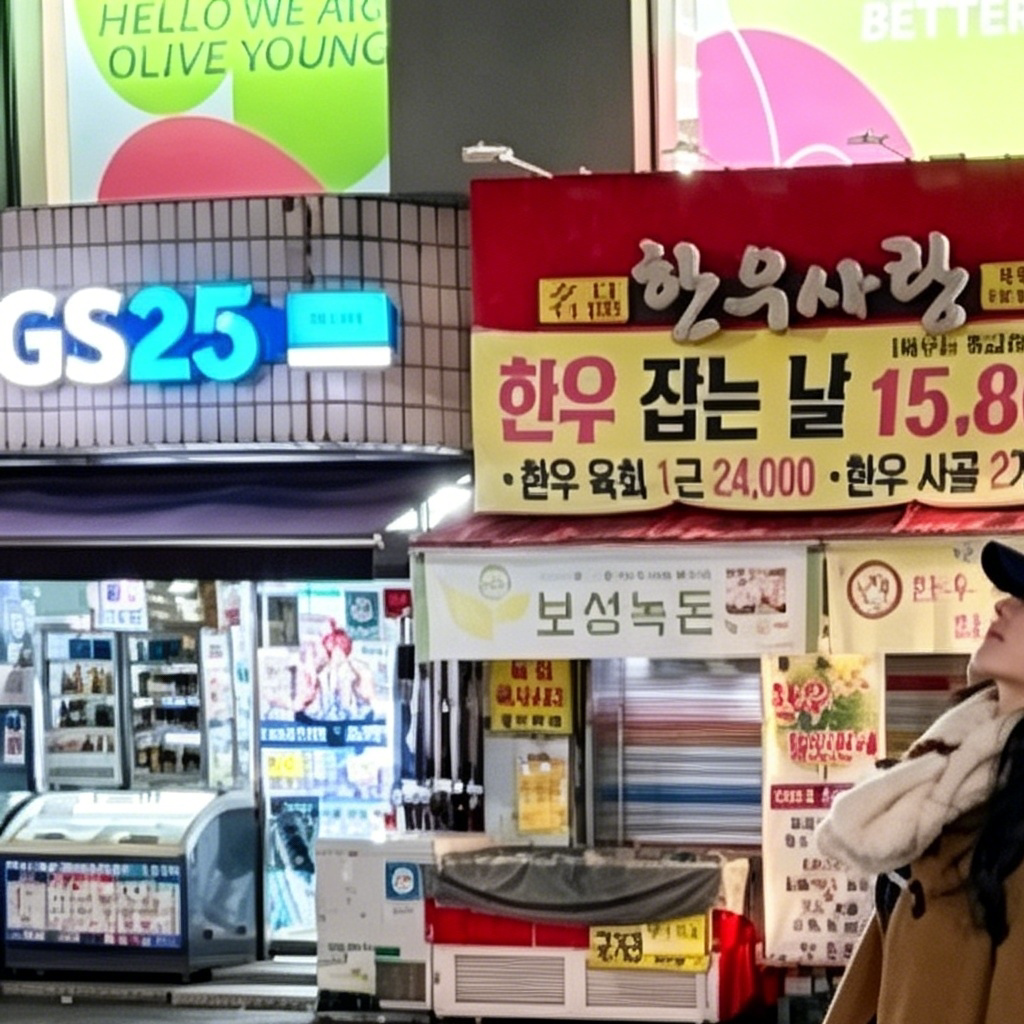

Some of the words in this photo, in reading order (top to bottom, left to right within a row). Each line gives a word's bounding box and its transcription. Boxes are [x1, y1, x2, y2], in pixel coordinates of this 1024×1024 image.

[98, 0, 231, 36] HELLO
[245, 0, 305, 28] WE
[108, 40, 228, 79] OLIVE
[240, 31, 385, 71] YOUNG
[631, 231, 969, 343] 한우사랑
[0, 284, 262, 388] GS25
[499, 356, 616, 443] 한우
[640, 356, 761, 441] 잡는
[789, 352, 851, 439] 날
[521, 458, 579, 500] 한우
[846, 453, 908, 498] 한우
[917, 451, 980, 493] 사골
[537, 589, 714, 637] 보성녹돈
